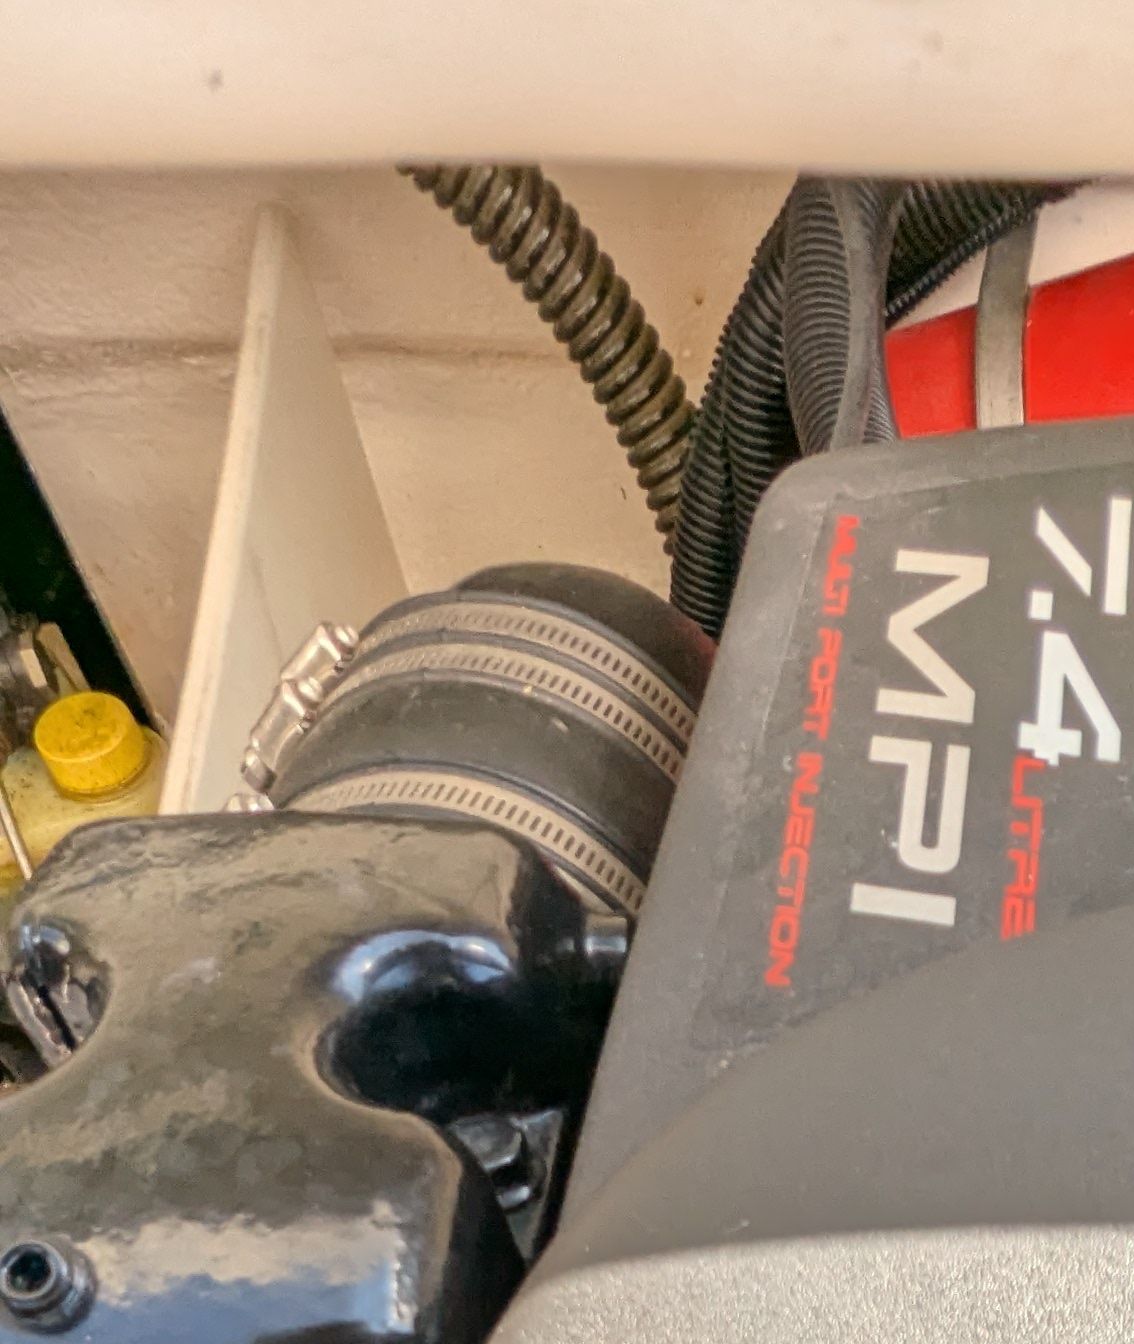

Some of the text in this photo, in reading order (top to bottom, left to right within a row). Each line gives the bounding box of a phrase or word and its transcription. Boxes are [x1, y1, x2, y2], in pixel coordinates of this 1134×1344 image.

[765, 514, 860, 987] MULTI PORT INJECTION
[849, 547, 990, 927] MPI
[1000, 494, 1133, 941] 7.4 LITRE
